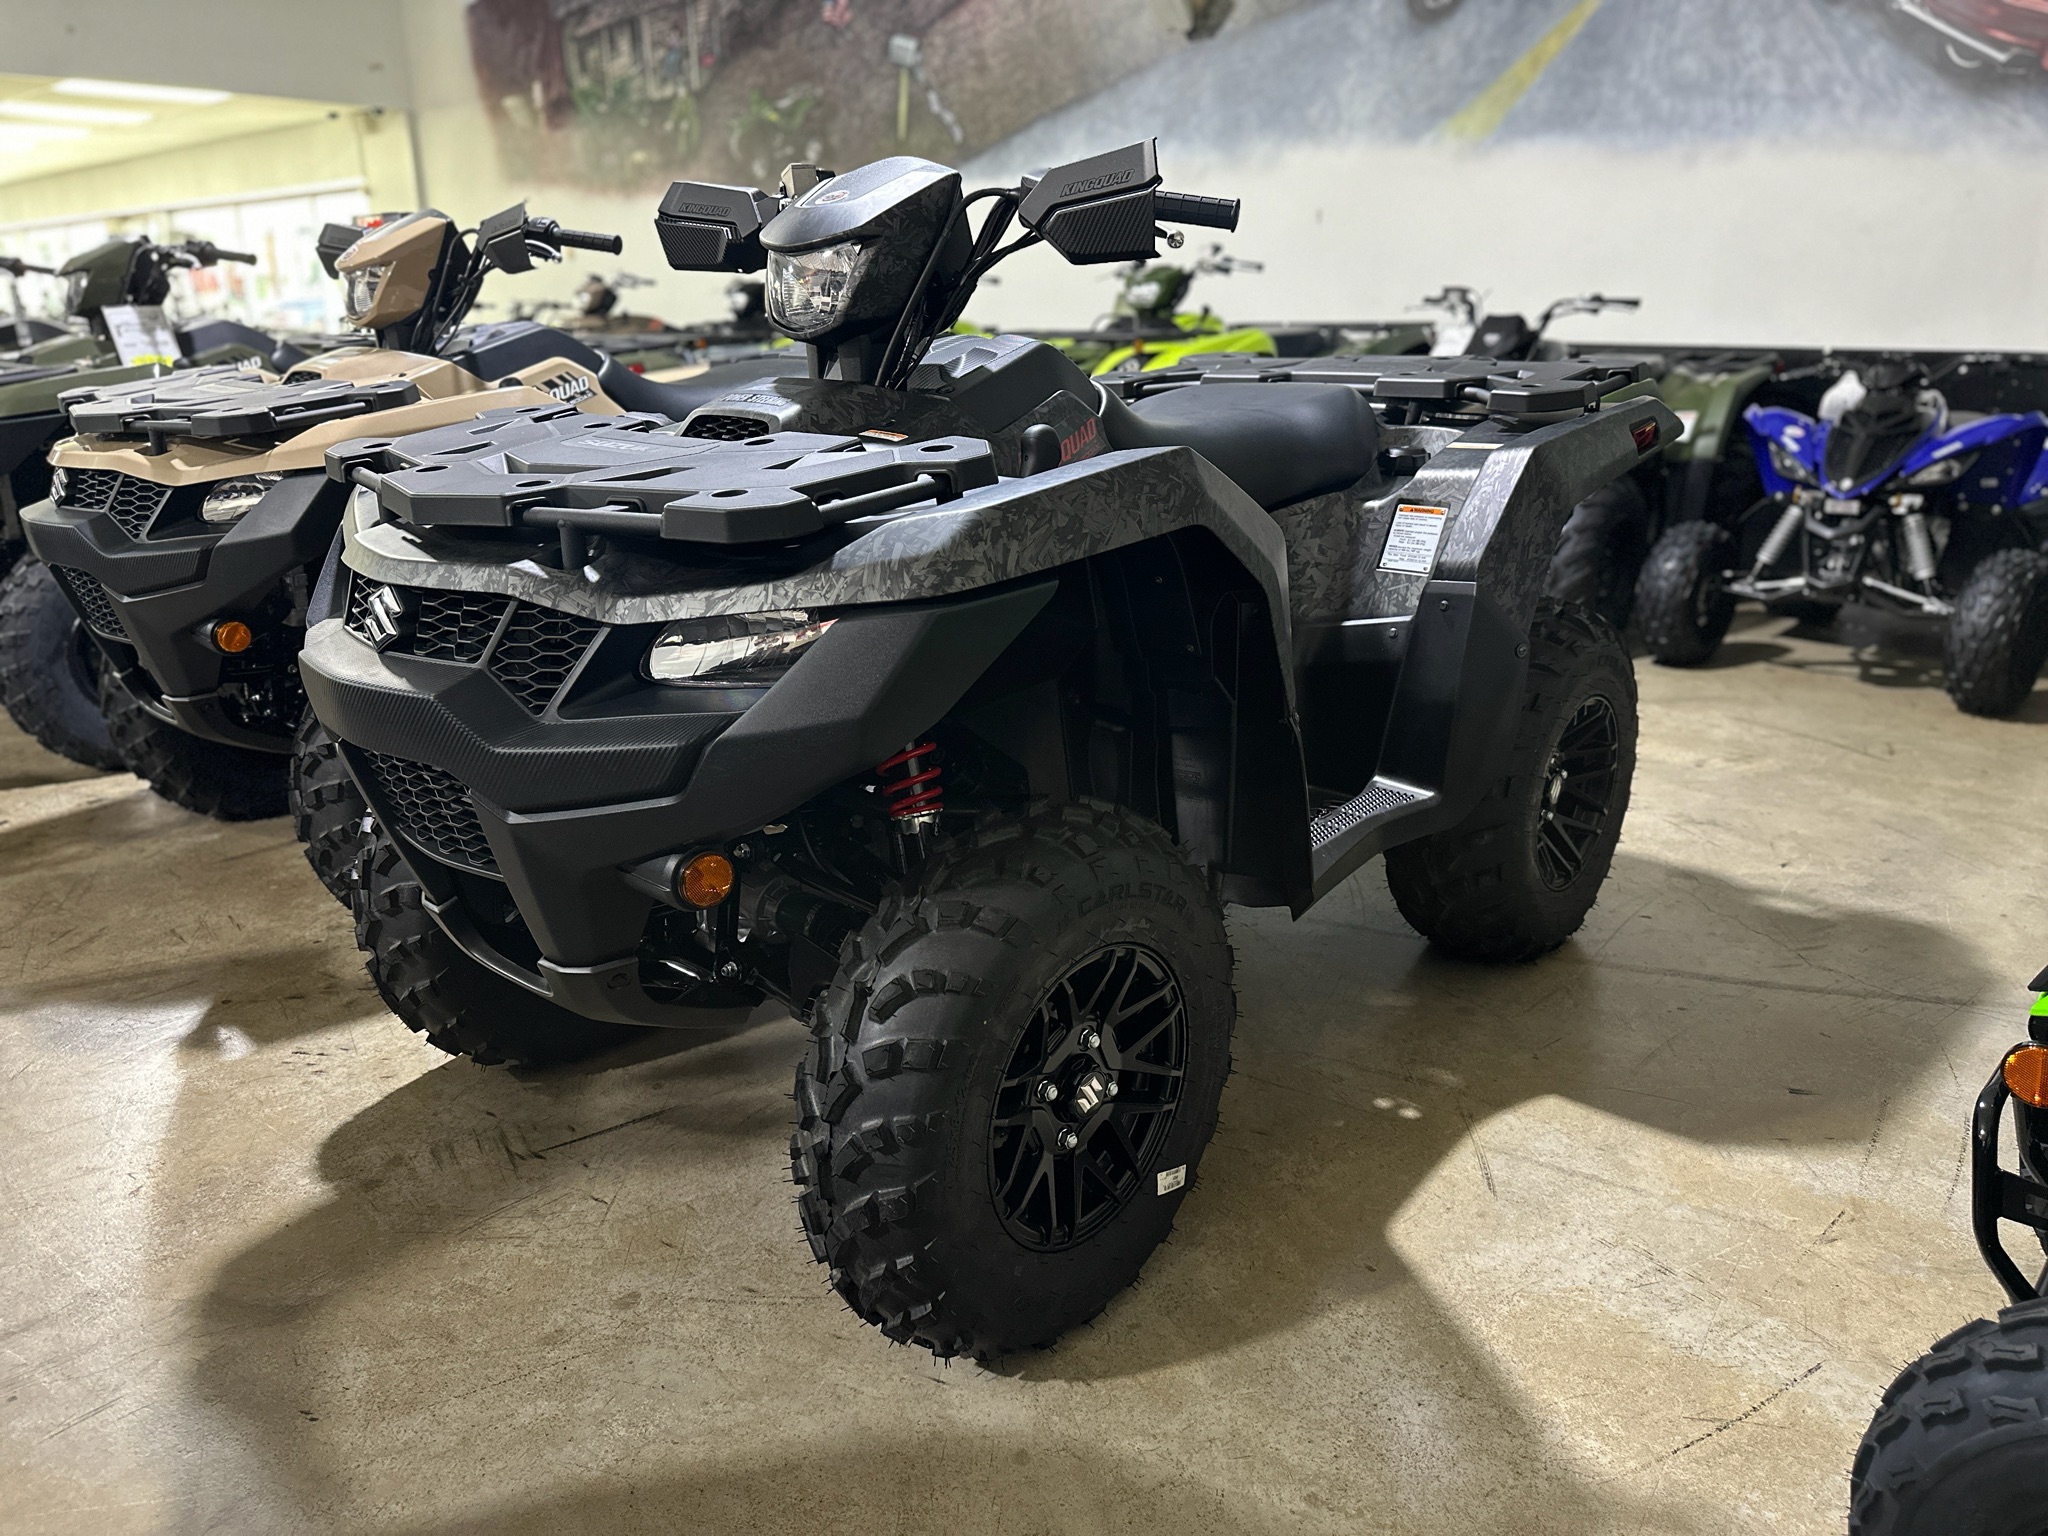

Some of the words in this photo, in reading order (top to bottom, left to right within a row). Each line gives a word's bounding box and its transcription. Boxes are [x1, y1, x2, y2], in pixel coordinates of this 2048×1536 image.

[1060, 168, 1135, 198] KINGQUAD
[679, 202, 731, 217] KINGQUAD
[1060, 417, 1097, 462] QUAD
[1078, 881, 1187, 917] CARLSTAR
